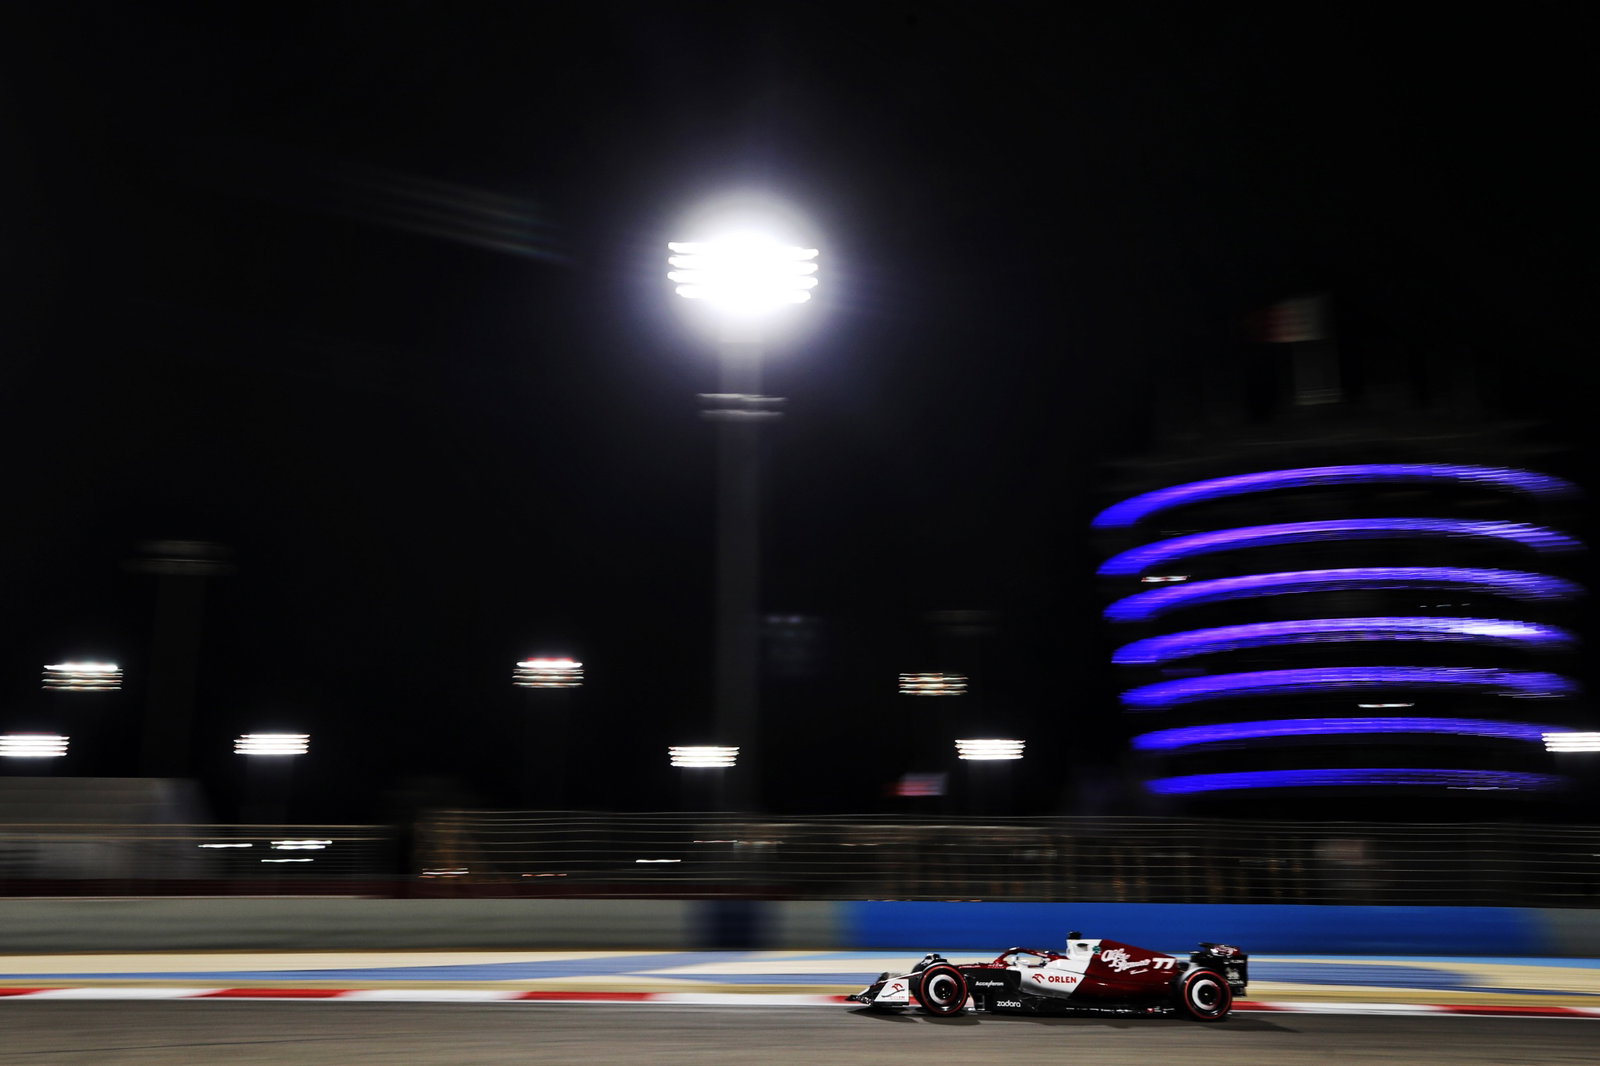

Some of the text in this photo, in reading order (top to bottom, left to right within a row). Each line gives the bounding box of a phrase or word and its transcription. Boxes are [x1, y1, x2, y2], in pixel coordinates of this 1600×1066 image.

[1152, 957, 1176, 970] 77
[1048, 975, 1077, 984] ORLEN
[996, 1000, 1021, 1008] zadara
